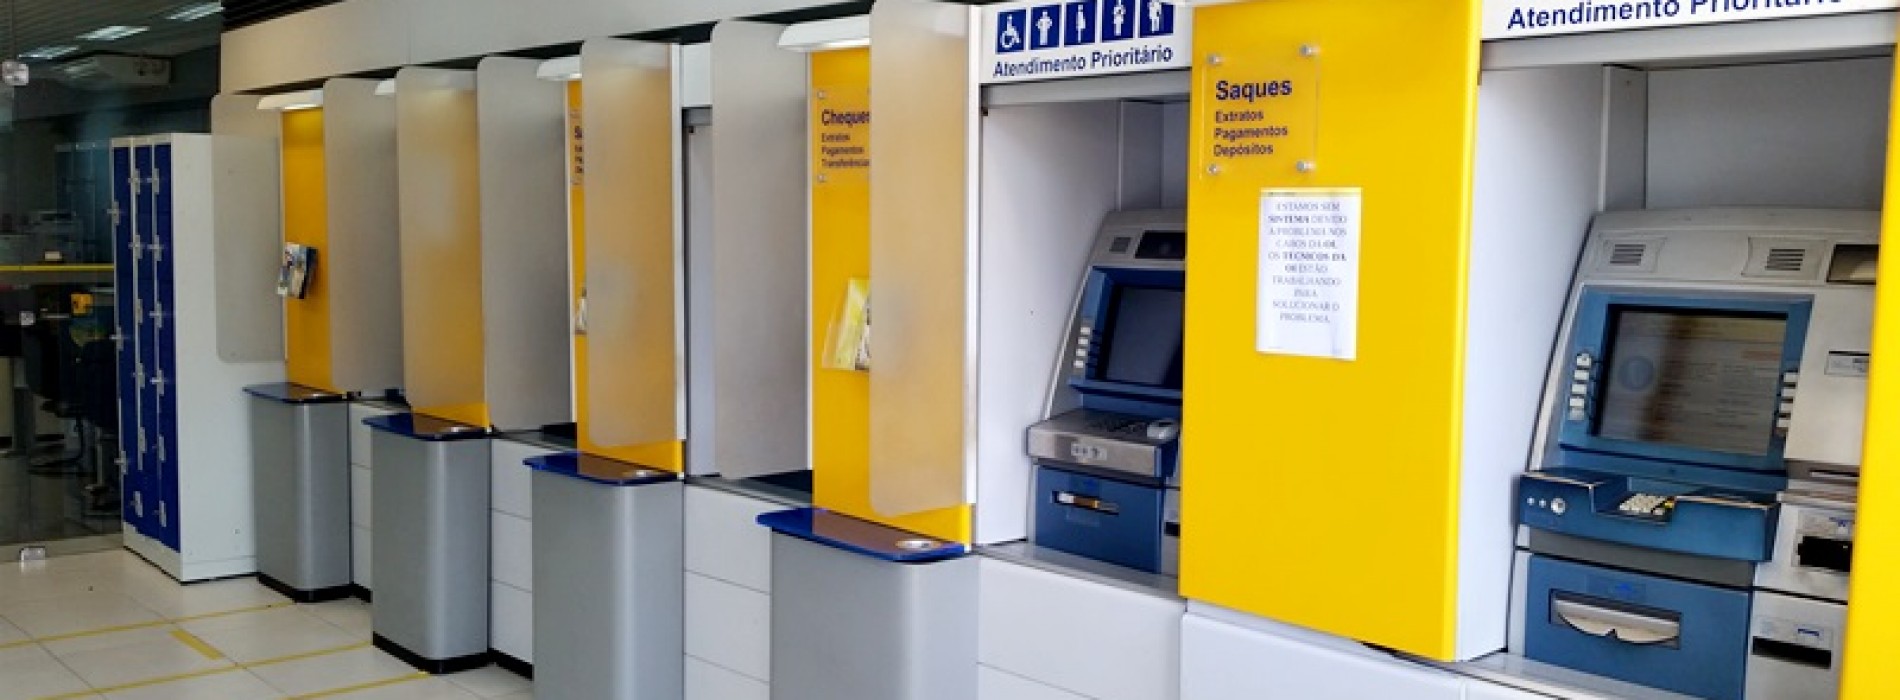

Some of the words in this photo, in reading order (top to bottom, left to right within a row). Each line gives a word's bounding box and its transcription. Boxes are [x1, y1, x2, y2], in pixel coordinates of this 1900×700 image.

[1507, 0, 1680, 30] Atendimento
[993, 54, 1086, 79] Atendimento
[1091, 45, 1173, 70] Prioritário
[1215, 80, 1293, 102] Saques
[1214, 110, 1264, 123] Extratos
[1213, 126, 1288, 141] Pagamentos
[1213, 143, 1274, 158] Depósitos
[1276, 202, 1319, 212] ESTAMOS
[1320, 202, 1341, 212] SEM
[1268, 215, 1310, 224] SISTEMA
[1311, 215, 1348, 224] DEVIDO
[1272, 275, 1342, 287] TRABALHANDO
